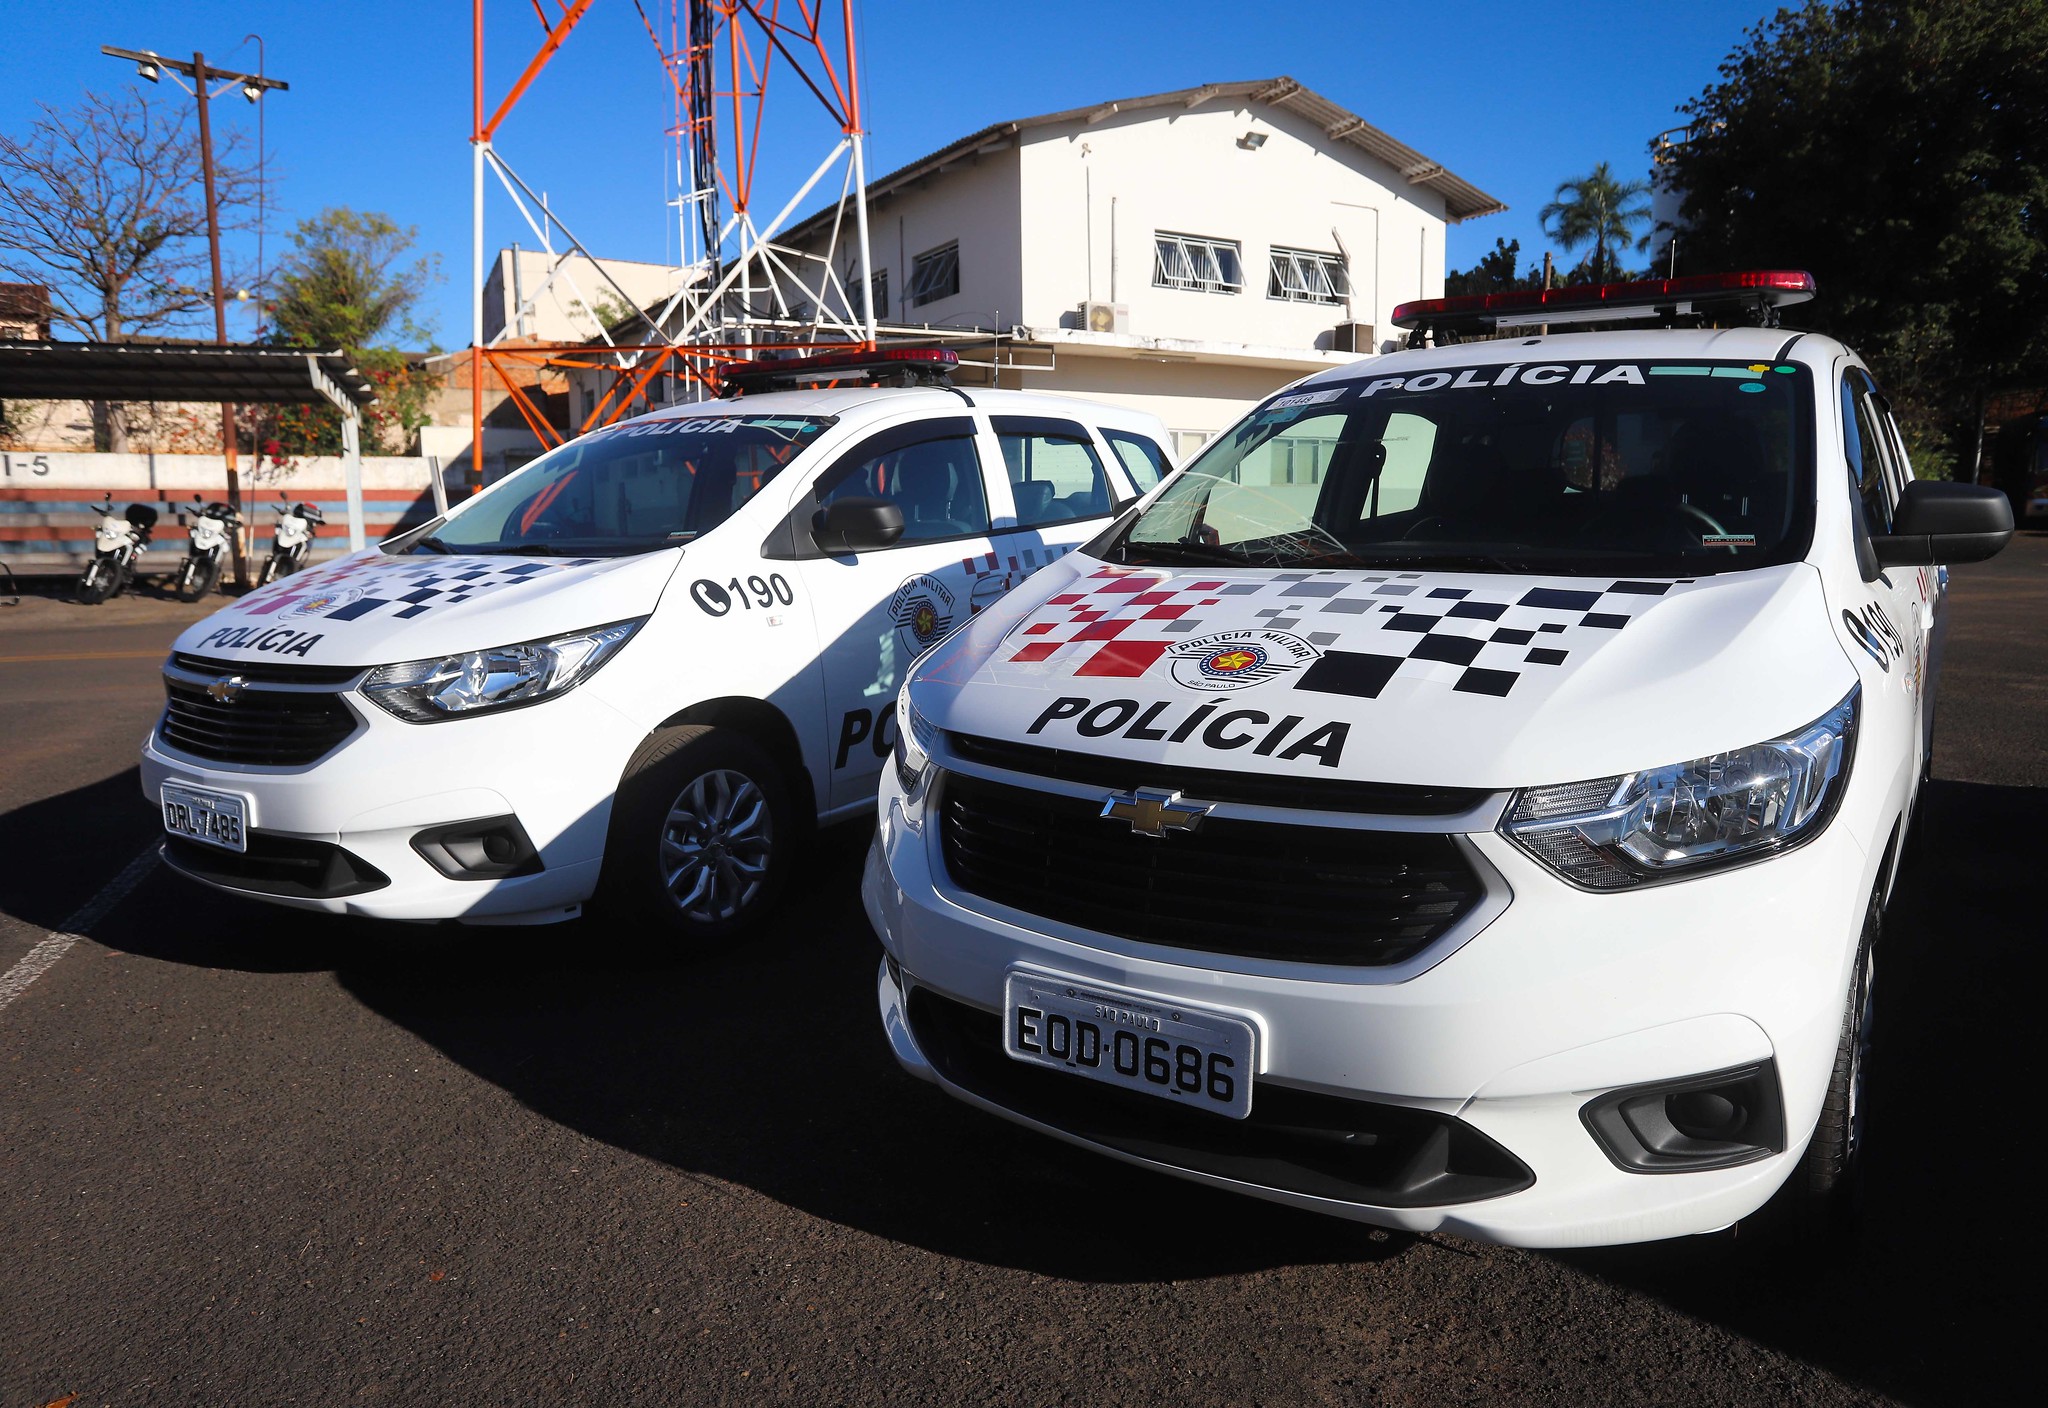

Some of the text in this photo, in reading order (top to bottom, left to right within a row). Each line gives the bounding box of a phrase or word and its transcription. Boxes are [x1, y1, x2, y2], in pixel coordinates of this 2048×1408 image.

[1358, 363, 1646, 398] POLÍCIA
[728, 573, 794, 610] 190
[920, 577, 951, 606] MILITAR
[196, 624, 325, 658] POLÍCIA
[1260, 632, 1310, 659] MILITAR
[1025, 698, 1352, 769] POLÍCIA
[1122, 1011, 1160, 1032] PAULO
